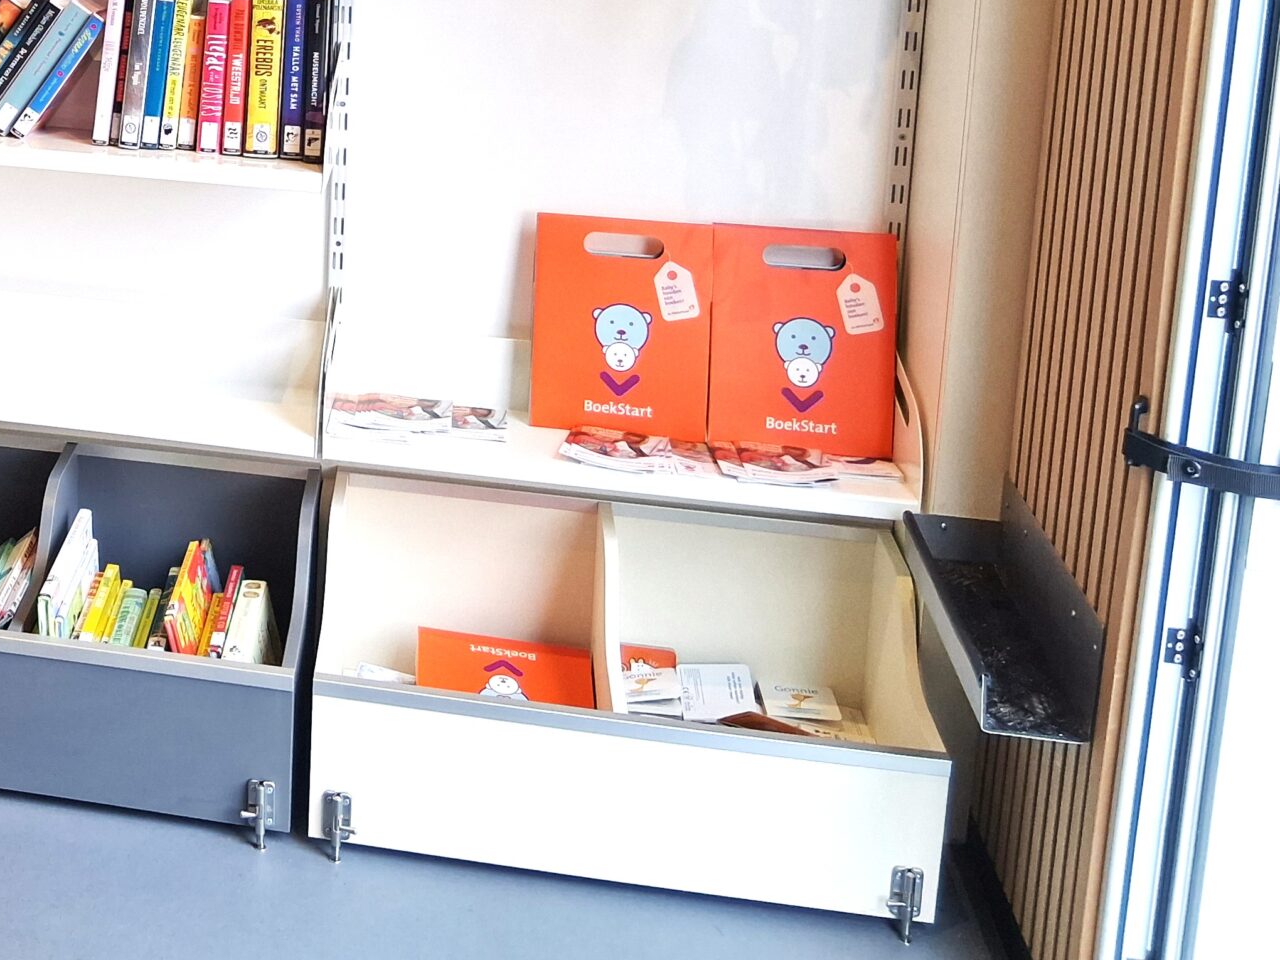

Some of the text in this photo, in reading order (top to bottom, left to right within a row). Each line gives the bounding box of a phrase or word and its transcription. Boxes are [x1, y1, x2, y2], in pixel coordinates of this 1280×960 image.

[169, 38, 181, 76] LEUGENAAR
[255, 39, 274, 76] EREBOS
[291, 46, 300, 74] HALLO,
[230, 54, 243, 104] TWEESTRIJD
[310, 52, 320, 106] MUSEUMNACHT
[201, 82, 221, 117] LOSERS
[290, 93, 298, 110] SAM
[583, 399, 653, 418] BoekStart
[765, 416, 837, 435] BoekStart
[470, 643, 537, 661] BoekStart
[774, 685, 818, 694] Gonnie
